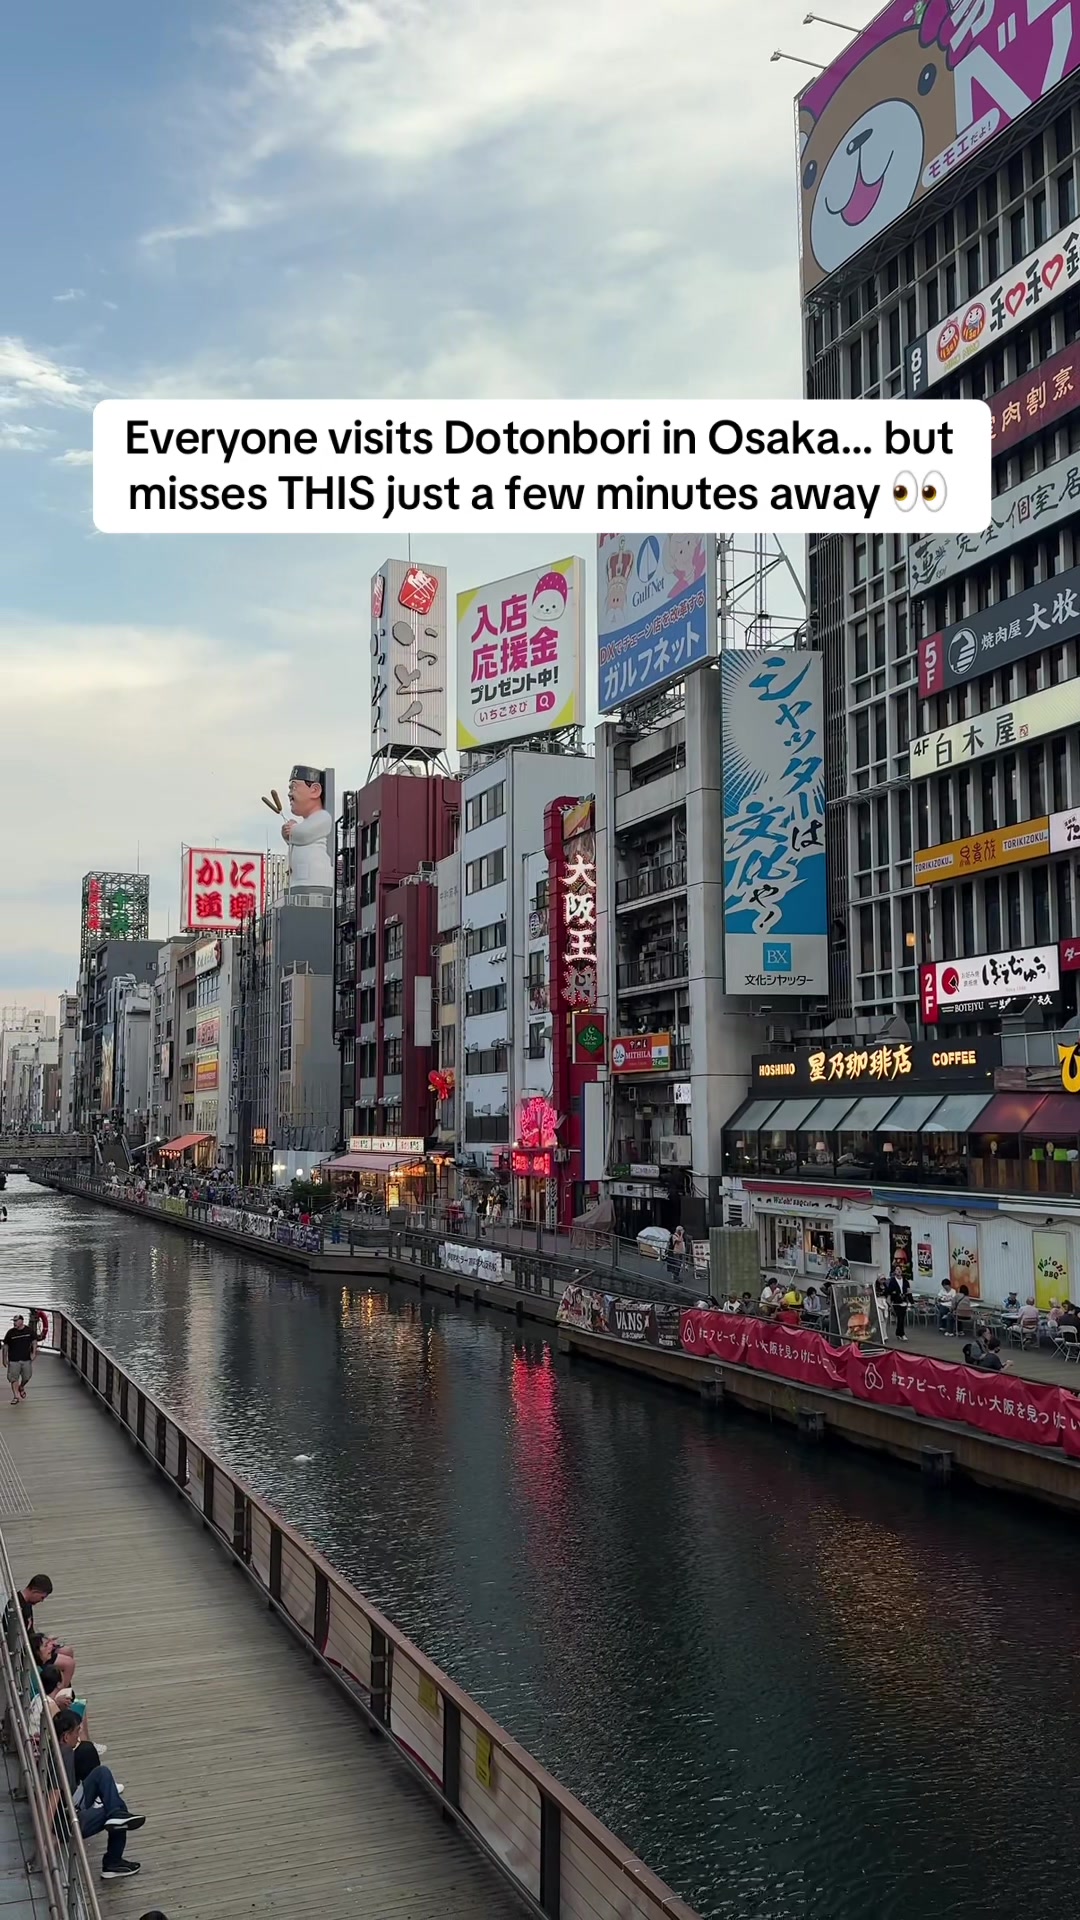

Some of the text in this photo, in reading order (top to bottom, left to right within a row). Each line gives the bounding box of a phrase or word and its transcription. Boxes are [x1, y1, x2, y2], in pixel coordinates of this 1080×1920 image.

[928, 121, 992, 179] モモエだよ!
[910, 347, 922, 392] 8F
[471, 593, 528, 643] 入店
[981, 618, 1022, 652] 焼肉屋
[470, 626, 558, 684] 応援金
[604, 621, 700, 702] ガルフネット
[924, 641, 937, 690] 5F
[470, 665, 559, 705] プレゼント中!
[479, 701, 528, 723] いちごなび
[913, 737, 930, 758] 4F
[936, 712, 1017, 769] 白木屋
[1003, 831, 1045, 851] TORIKIZOKU
[196, 857, 257, 890] かに
[915, 858, 950, 873] TORIKIZOKU
[558, 854, 598, 1008] 大阪王将
[766, 949, 787, 965] BX
[924, 973, 934, 1015] 2F
[954, 1001, 985, 1013] BOTEJYU
[625, 1050, 652, 1060] MITHILA
[759, 1063, 796, 1077] HOSHINO
[808, 1044, 913, 1083] 星乃珈琲店
[932, 1050, 977, 1067] COFFEE
[1043, 1271, 1059, 1280] BBQ
[615, 1311, 643, 1331] VANS
